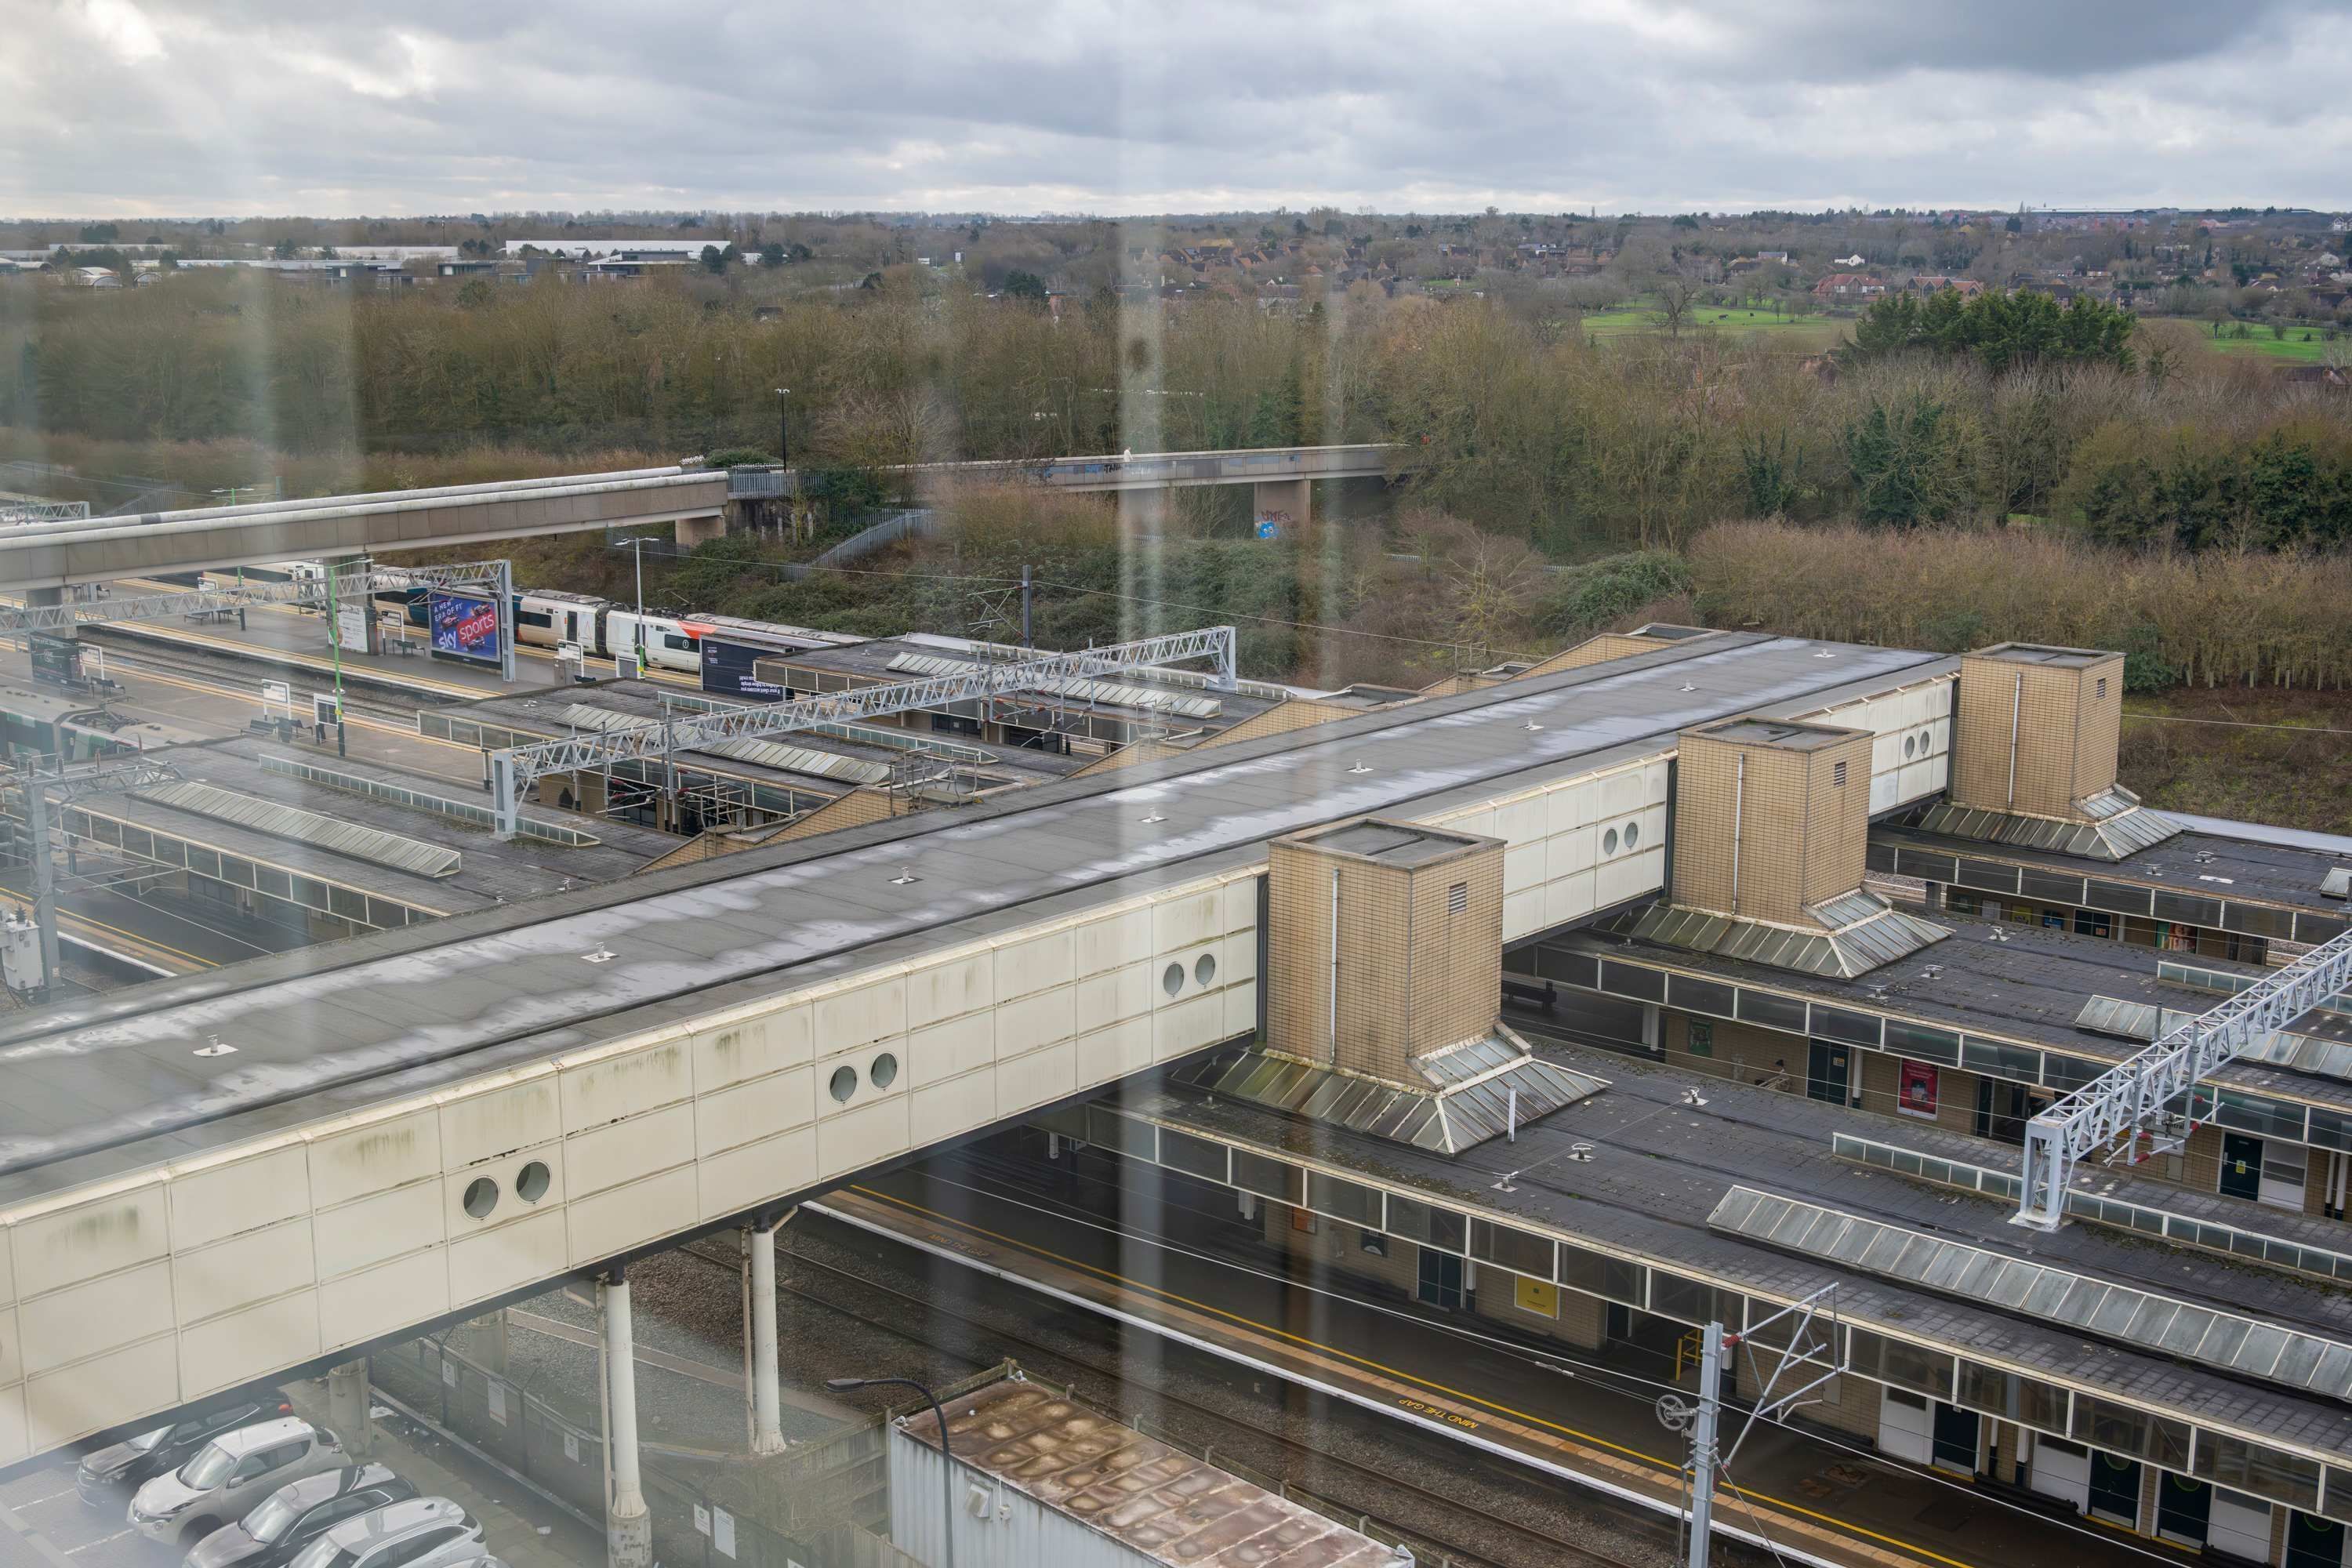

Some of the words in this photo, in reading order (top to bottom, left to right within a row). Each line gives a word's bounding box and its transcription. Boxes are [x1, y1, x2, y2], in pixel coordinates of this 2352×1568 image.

[434, 613, 446, 622] ERA
[459, 614, 495, 641] sports
[439, 630, 456, 649] sky
[1399, 1399, 1425, 1410] GAP
[1424, 1406, 1446, 1418] THE
[1447, 1415, 1479, 1428] MIND
